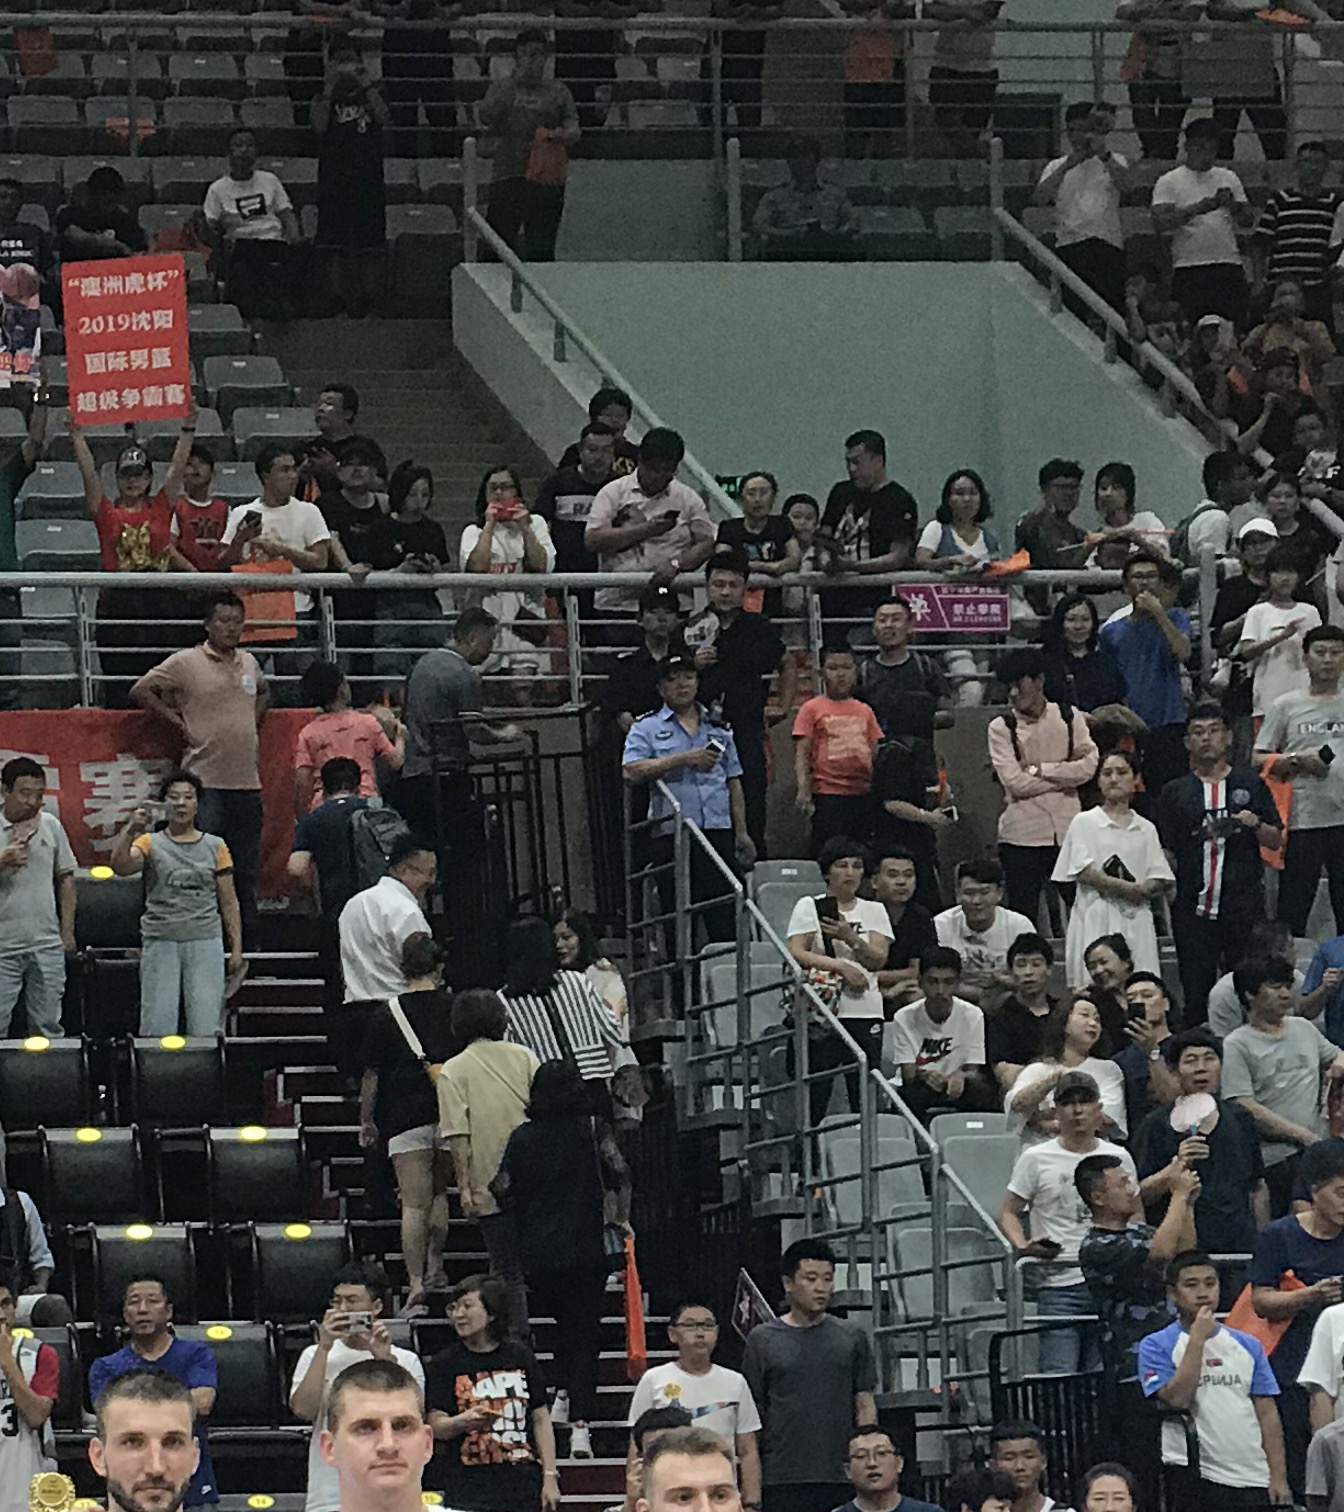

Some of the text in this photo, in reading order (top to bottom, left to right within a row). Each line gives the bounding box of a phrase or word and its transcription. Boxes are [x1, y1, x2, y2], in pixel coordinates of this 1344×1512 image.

[78, 309, 174, 335] 2019沈阳
[84, 346, 173, 375] 国际男篮
[921, 1037, 953, 1054] NIKE
